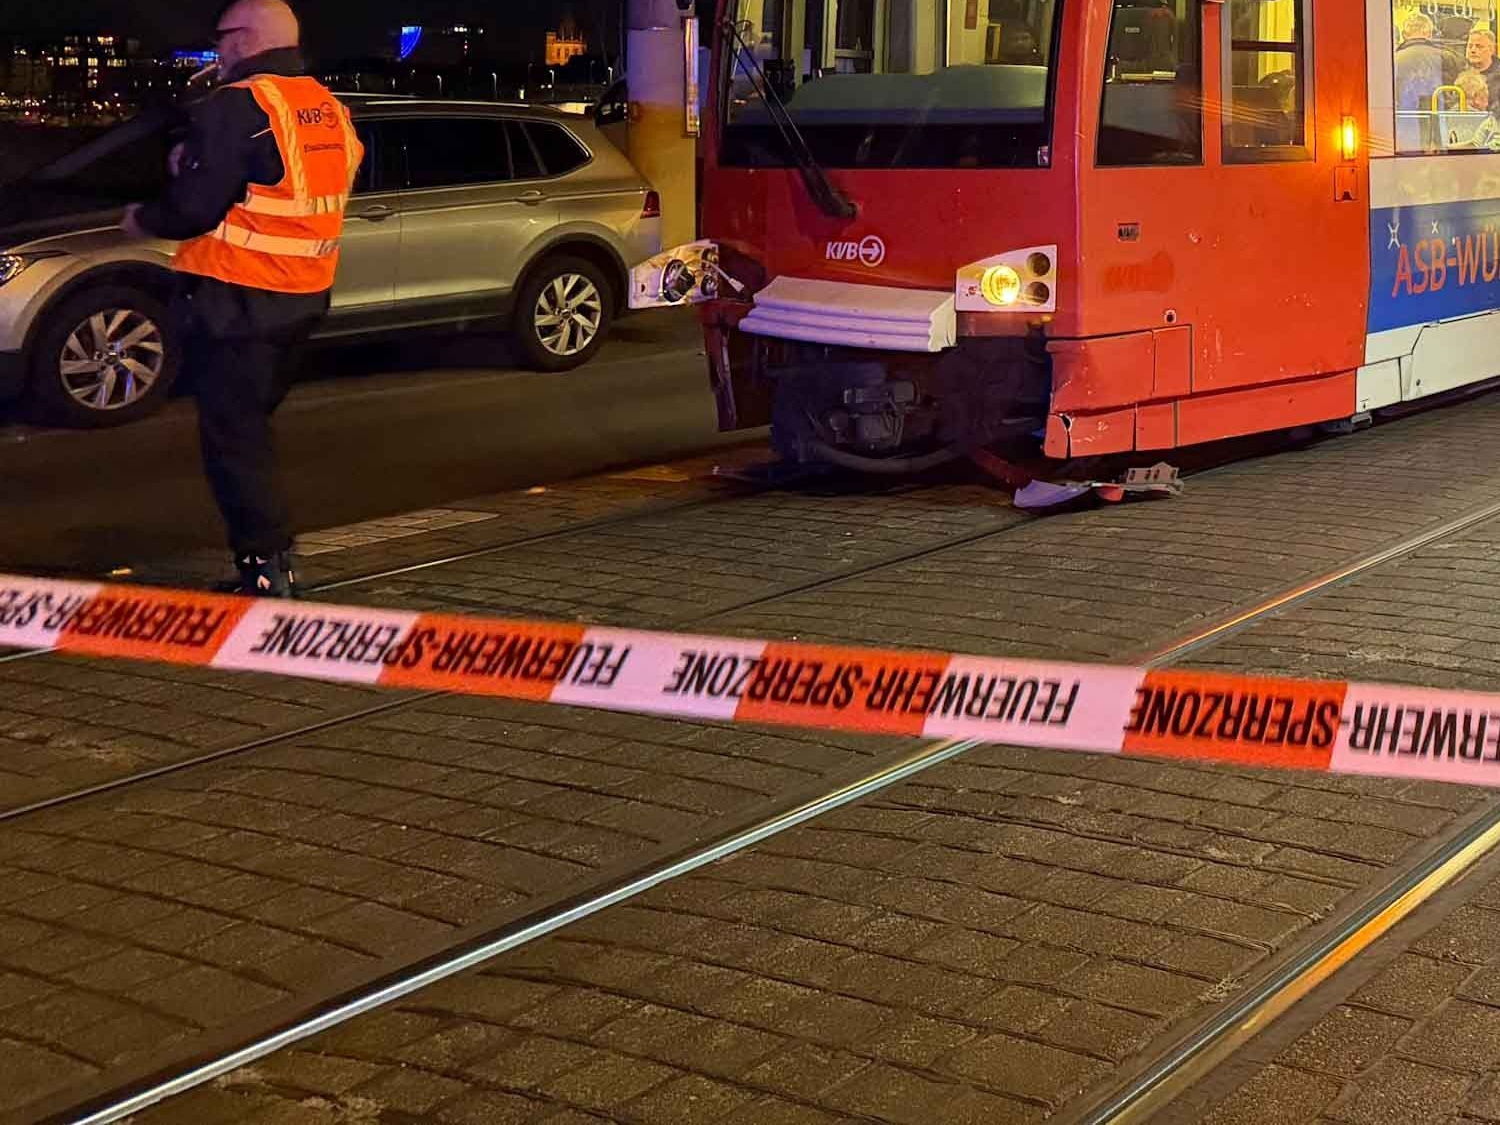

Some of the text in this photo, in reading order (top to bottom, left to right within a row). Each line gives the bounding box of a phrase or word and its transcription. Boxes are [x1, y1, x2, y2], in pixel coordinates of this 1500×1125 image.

[296, 107, 322, 126] KVB
[825, 241, 858, 260] KVB
[250, 613, 632, 689] FEUERWEHR-SPERRZONE
[662, 649, 1081, 726] FEUERWEHR-SPERRZONE
